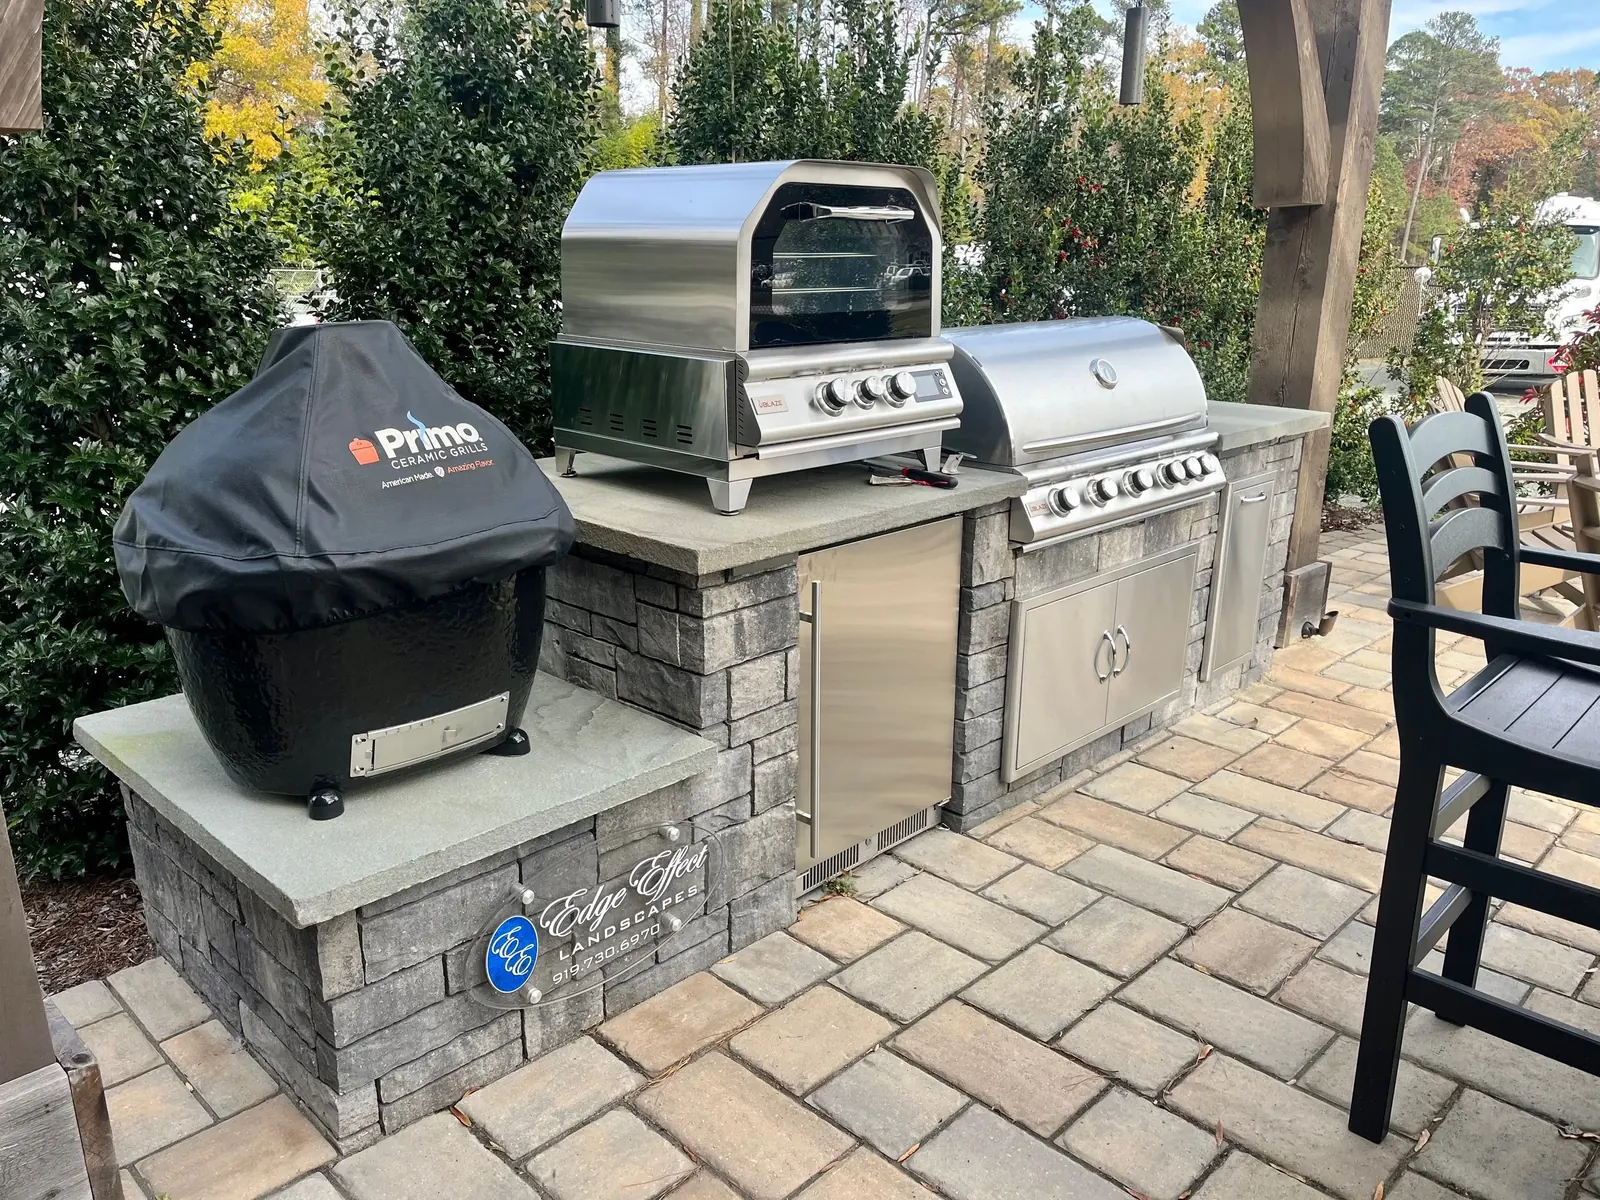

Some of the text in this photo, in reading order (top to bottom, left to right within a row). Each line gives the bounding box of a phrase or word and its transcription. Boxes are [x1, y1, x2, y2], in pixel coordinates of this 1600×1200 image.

[381, 476, 414, 490] American
[447, 461, 476, 474] Amazing
[391, 442, 488, 470] CERAMIC GRILLS
[540, 844, 708, 937] Edge Effect
[559, 885, 698, 960] LANDSCAPES
[552, 923, 660, 985] 919.730.6970
